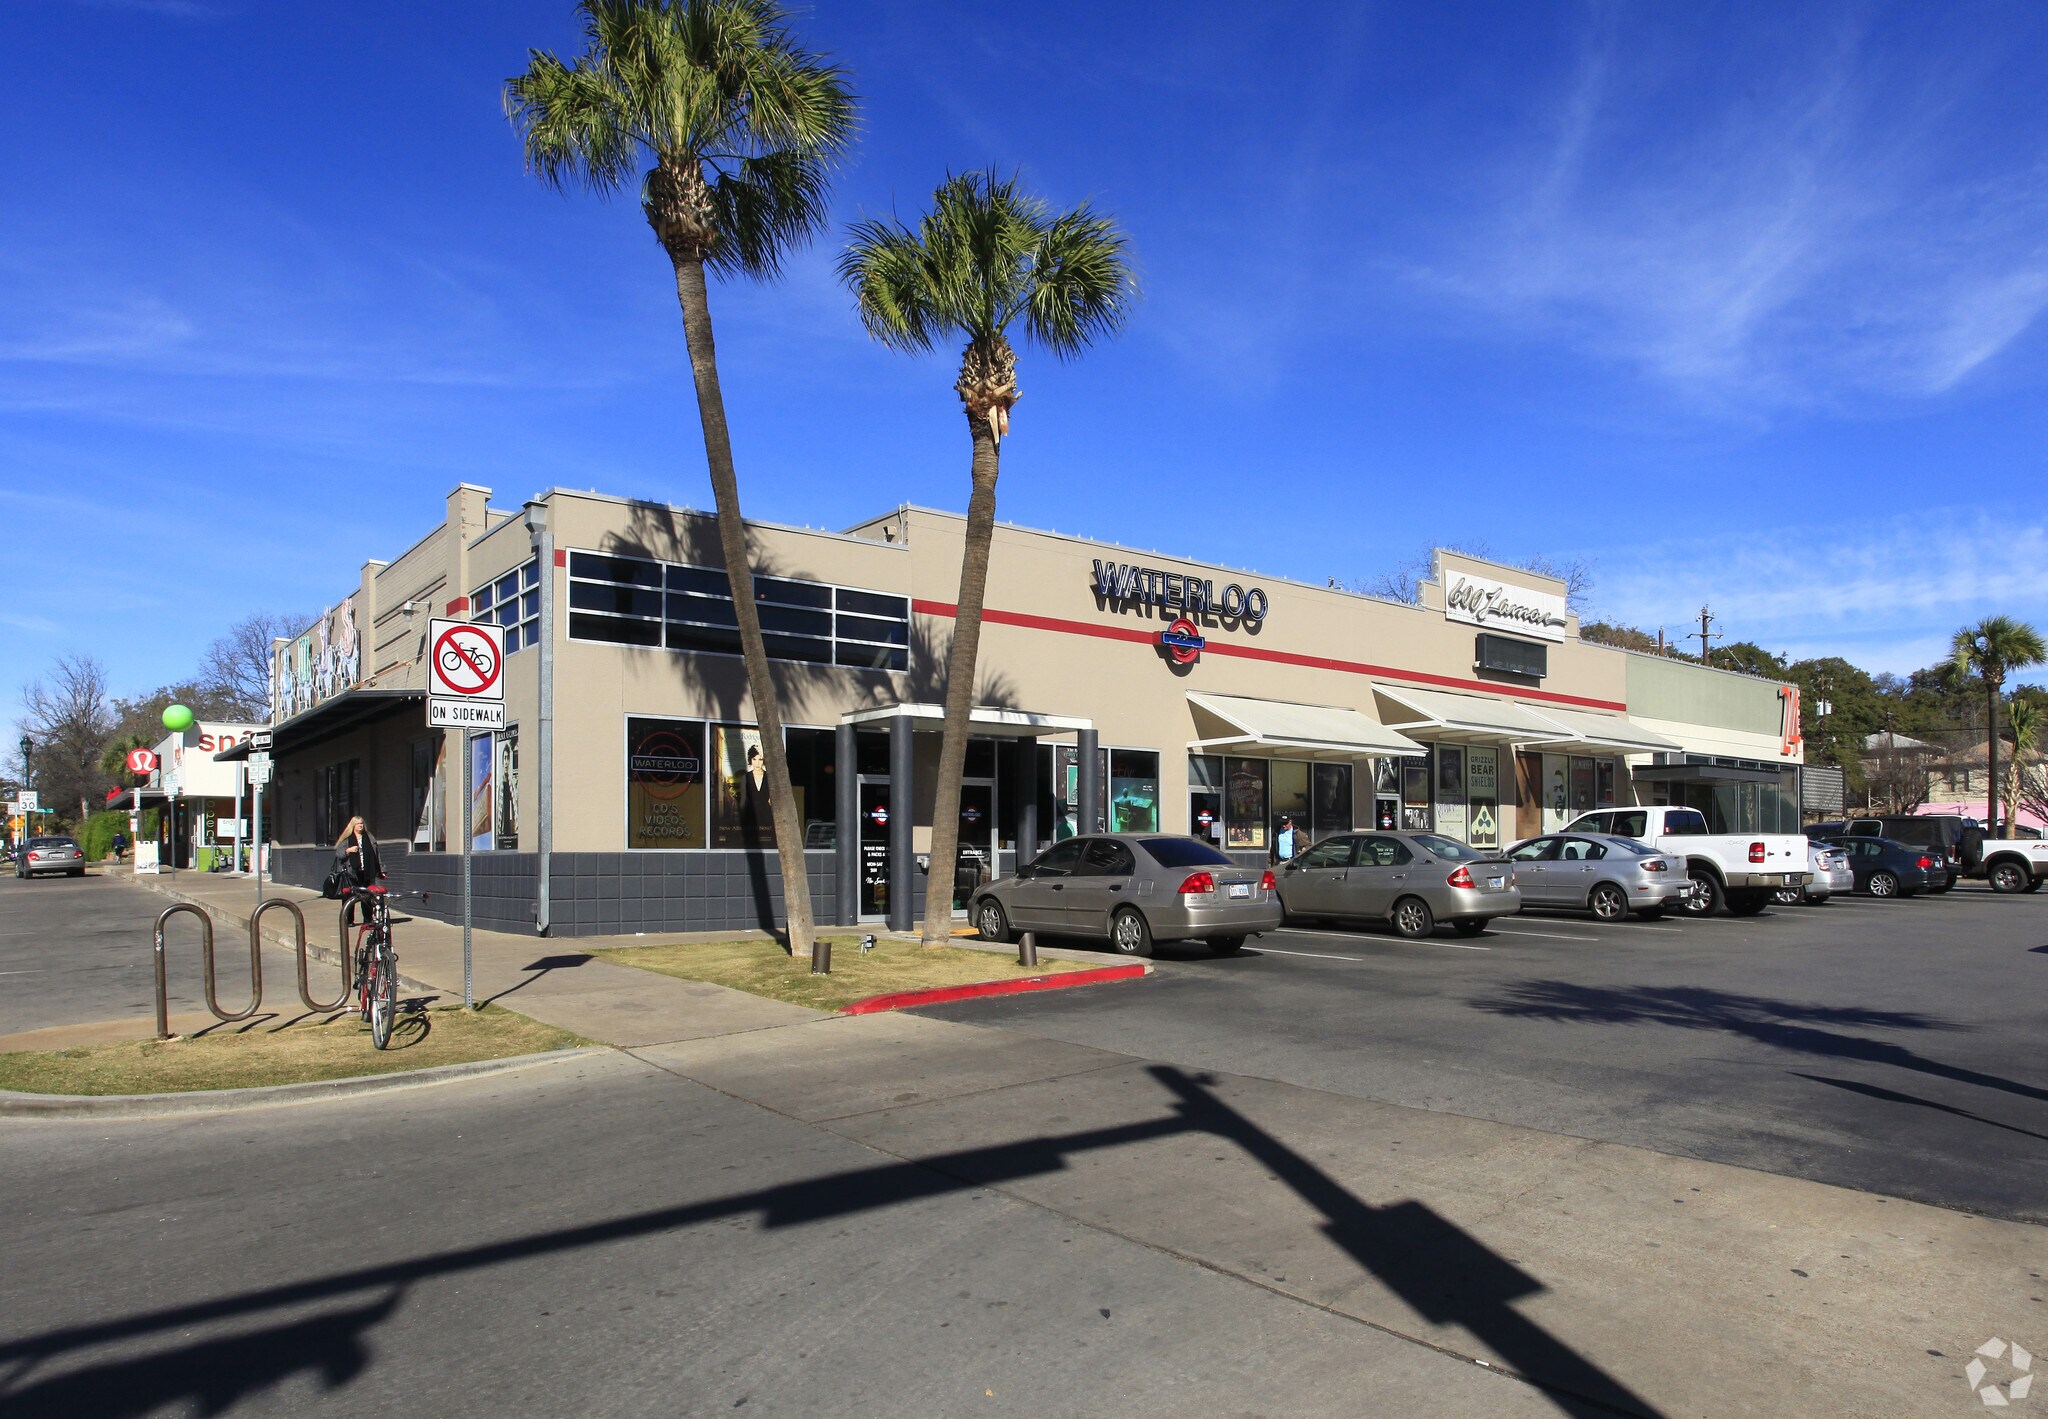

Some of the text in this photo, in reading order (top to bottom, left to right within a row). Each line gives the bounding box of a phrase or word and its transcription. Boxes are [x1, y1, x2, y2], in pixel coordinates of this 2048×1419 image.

[1093, 559, 1268, 621] WATERLOO
[1448, 577, 1567, 625] 600 Lamar
[433, 706, 502, 722] ON SIDEWALK
[635, 759, 693, 769] WATERLOO
[1471, 756, 1494, 765] GRIZZLY
[1471, 765, 1495, 775] BEAR
[1471, 776, 1496, 788] SHIELDS
[21, 801, 36, 810] 30
[653, 803, 679, 813] CD'S
[645, 815, 687, 825] VIDEOS
[639, 826, 692, 836] RECORDS
